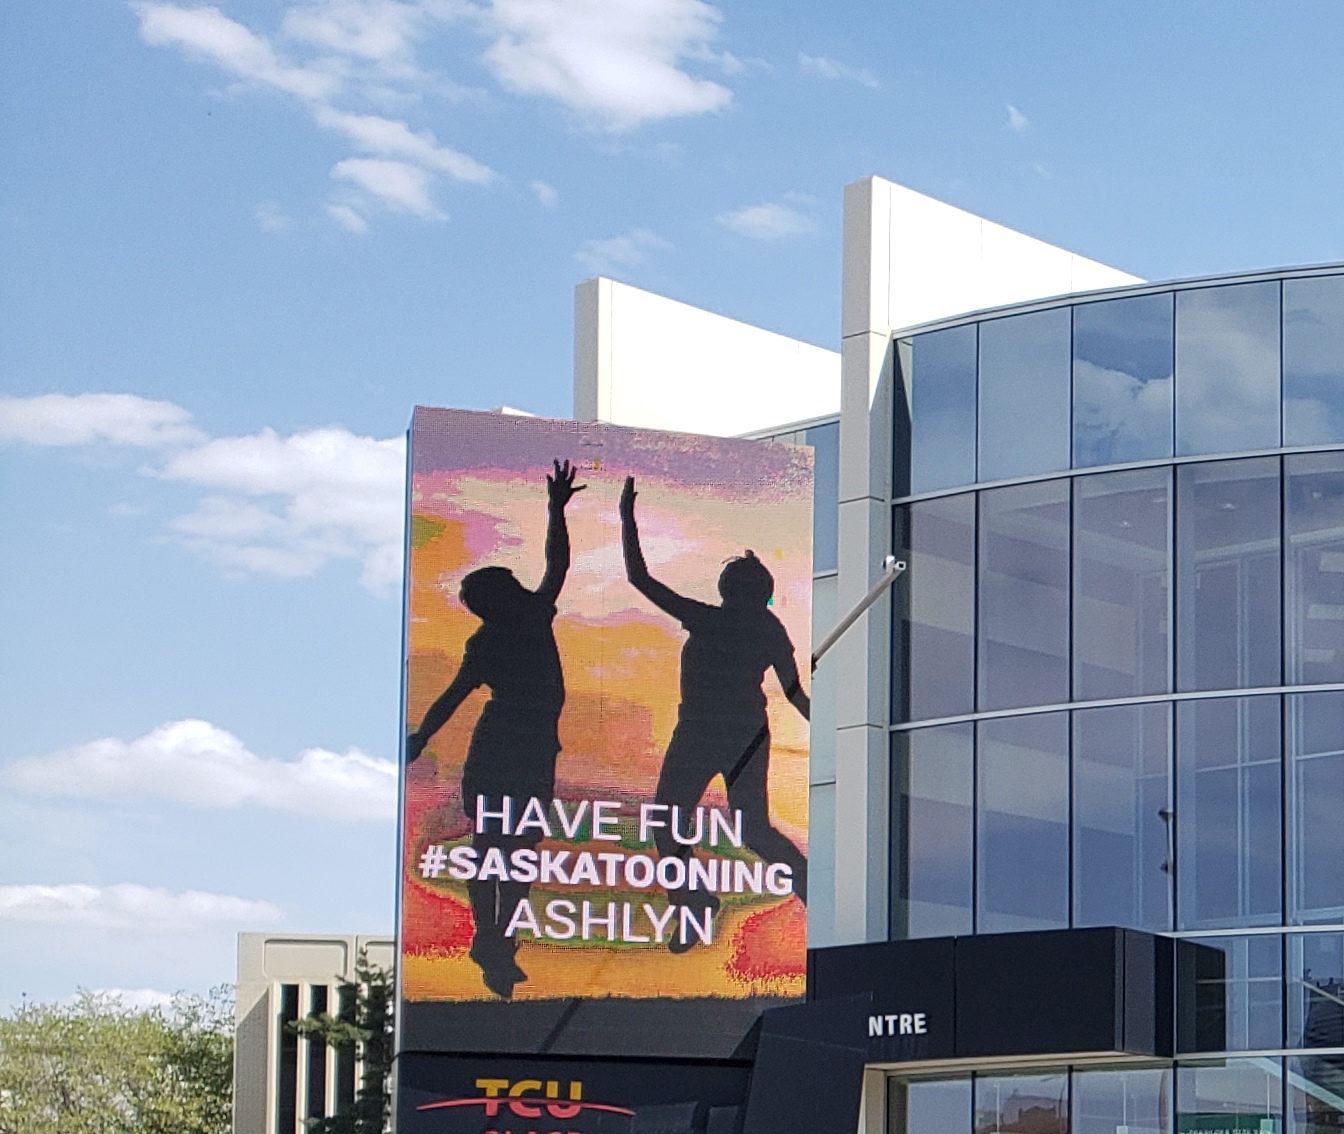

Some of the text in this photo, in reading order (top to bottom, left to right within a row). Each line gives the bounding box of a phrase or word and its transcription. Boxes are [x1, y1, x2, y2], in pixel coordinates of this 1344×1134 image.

[476, 794, 743, 848] HAVE FUN
[418, 844, 793, 896] #SASKATOONING
[504, 898, 713, 945] ASHLYN
[475, 1078, 582, 1119] TCU
